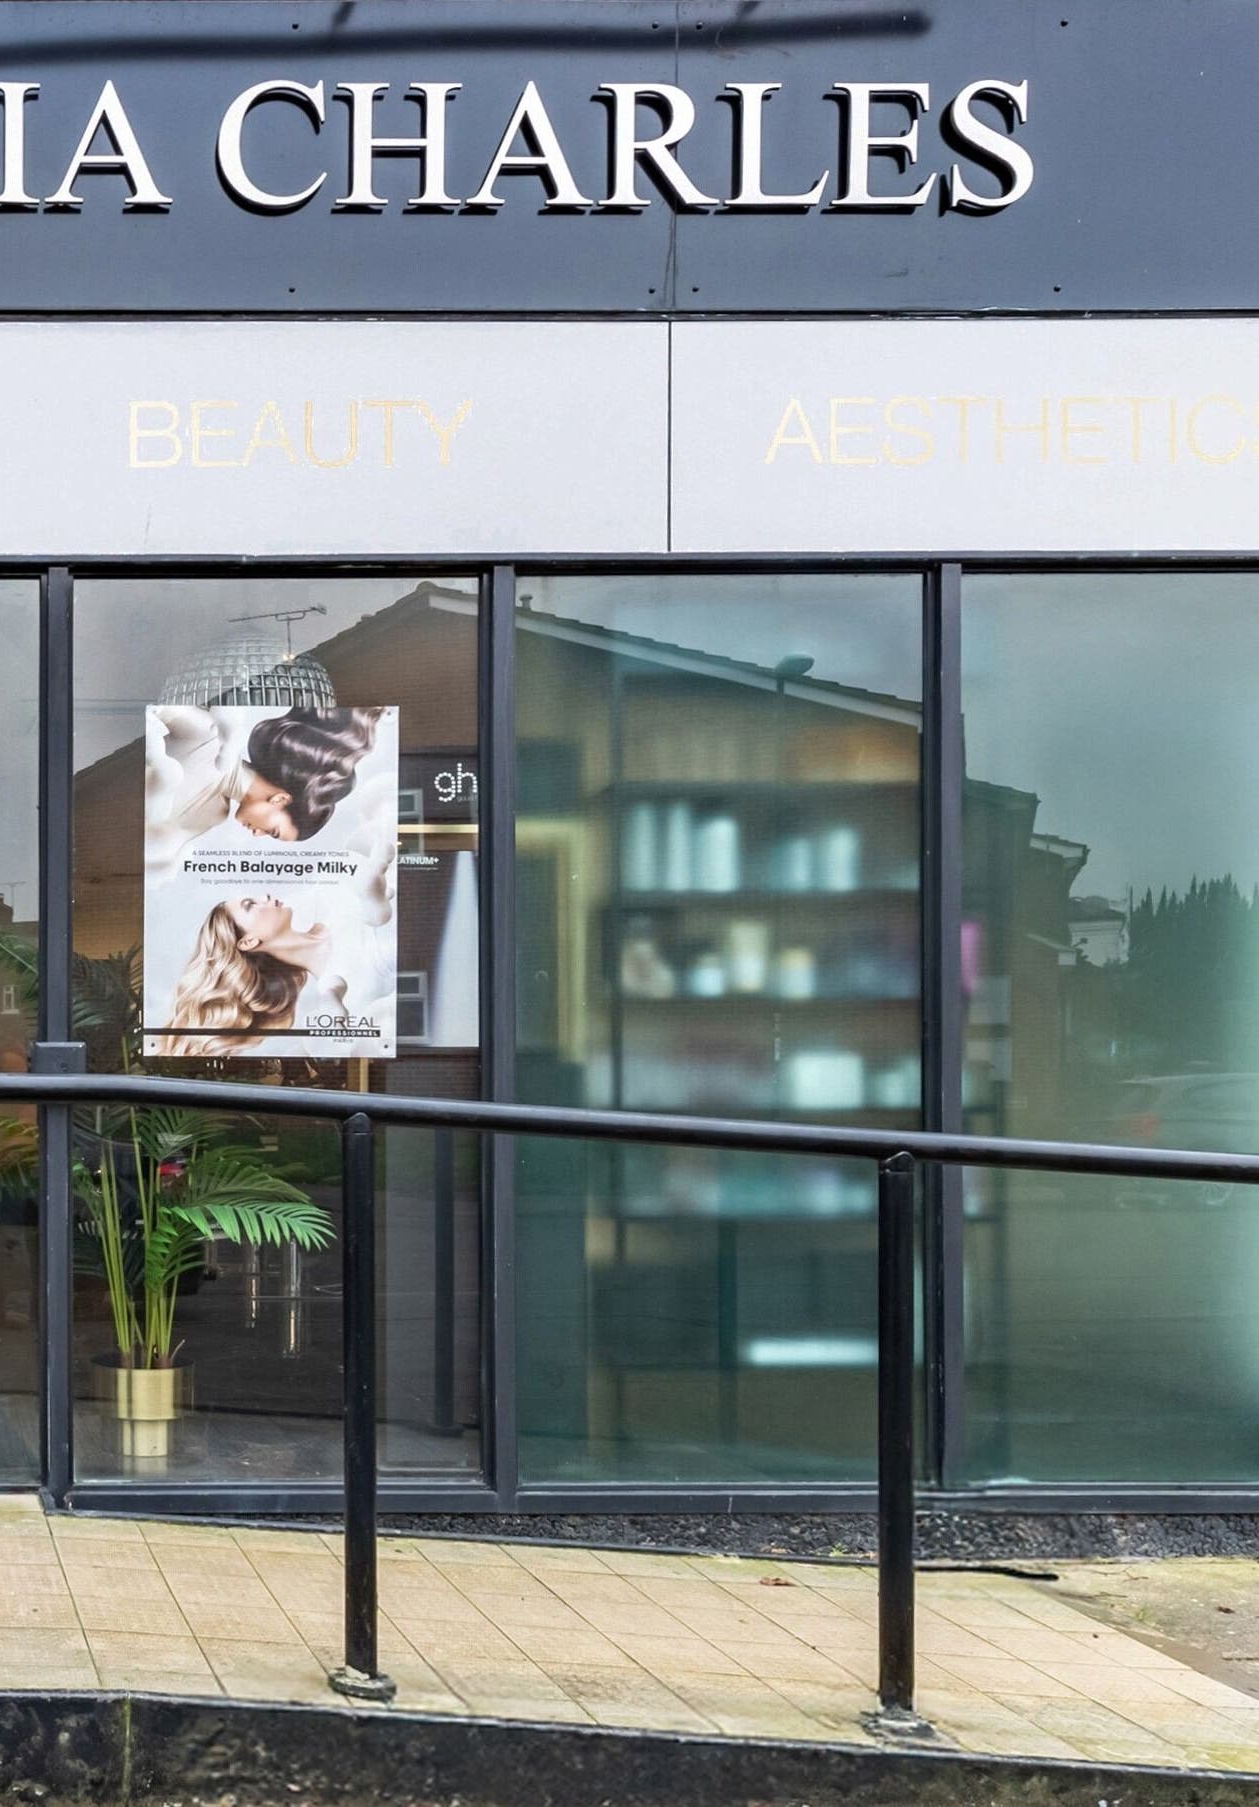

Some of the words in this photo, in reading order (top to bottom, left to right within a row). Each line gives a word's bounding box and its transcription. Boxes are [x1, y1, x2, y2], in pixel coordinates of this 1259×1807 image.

[216, 78, 1035, 212] CHARLES
[127, 398, 474, 469] BEAUTY
[184, 860, 236, 873] French
[241, 860, 313, 876] Balayage
[318, 861, 358, 876] Milky
